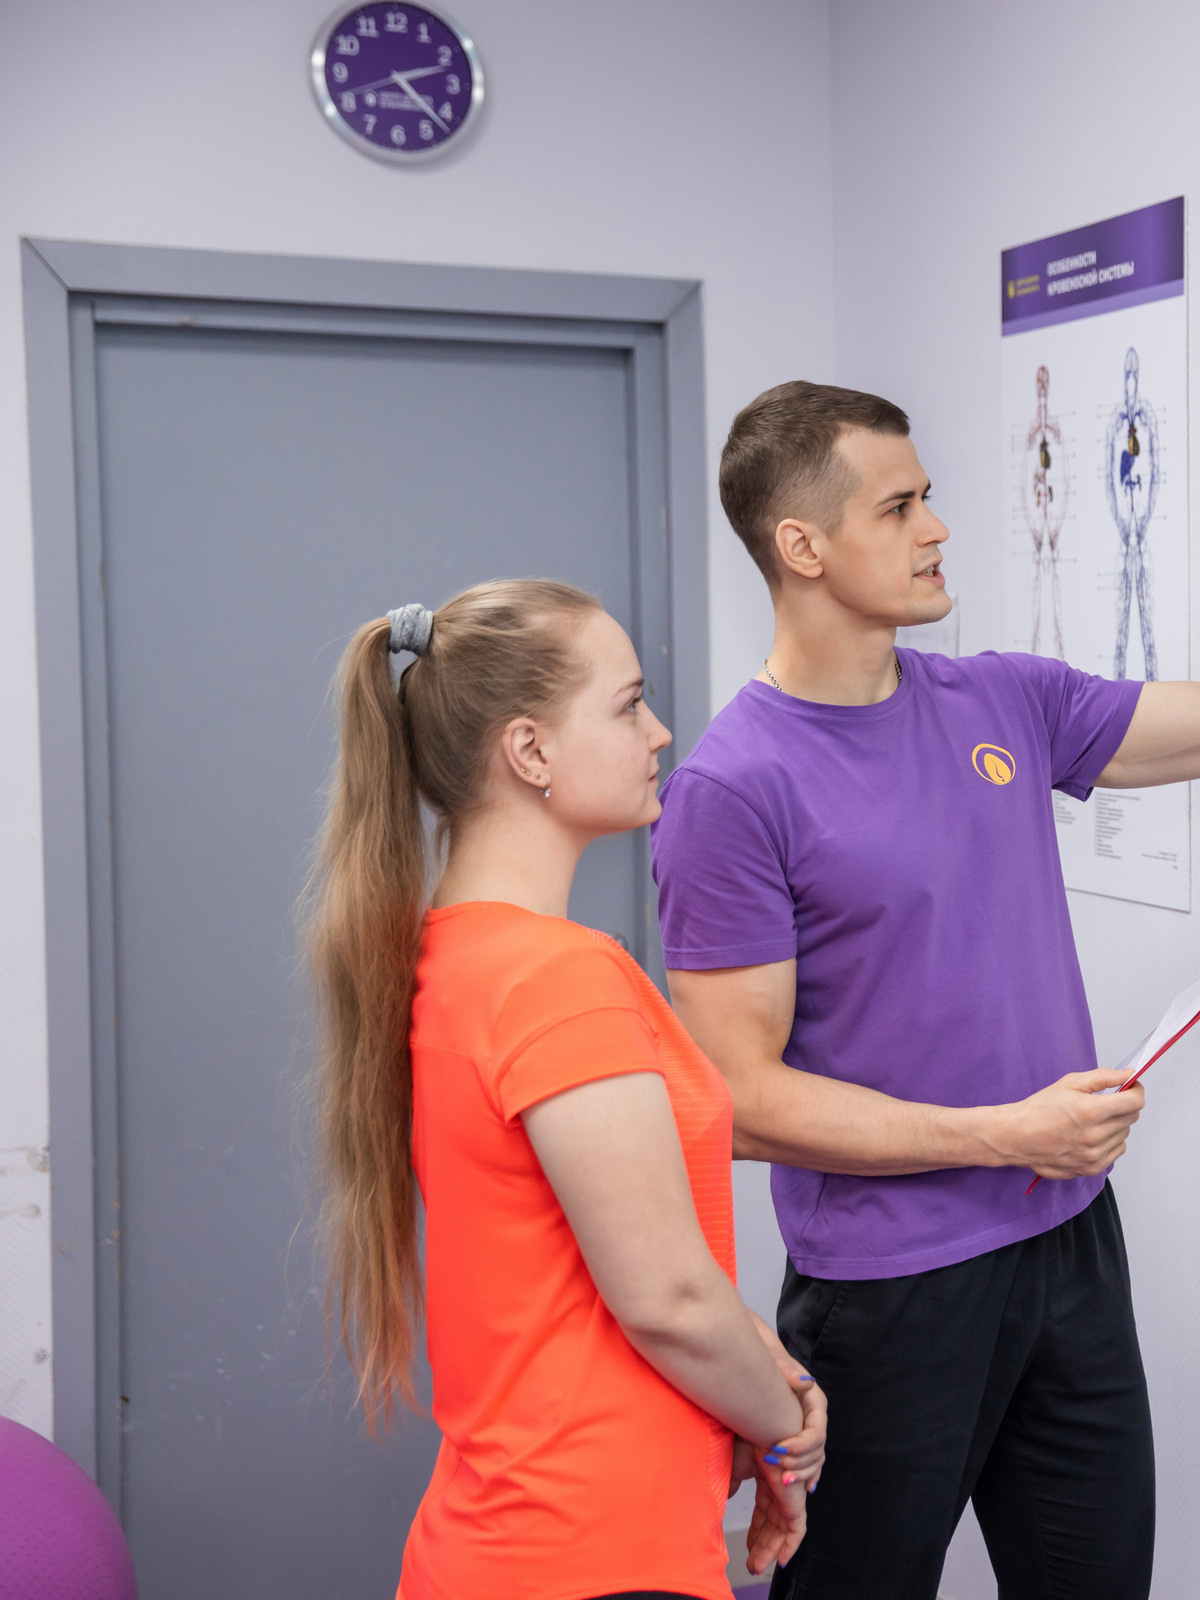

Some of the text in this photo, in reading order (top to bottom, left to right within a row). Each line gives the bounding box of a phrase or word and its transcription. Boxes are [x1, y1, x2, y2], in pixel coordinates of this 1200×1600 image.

[357, 16, 379, 37] 11
[385, 11, 408, 33] 12
[417, 22, 431, 43] 1
[335, 34, 360, 56] 10
[437, 45, 453, 67] 2
[332, 62, 348, 83] 9
[445, 73, 461, 95] 3
[340, 91, 357, 113] 8
[439, 101, 453, 122] 4
[362, 113, 378, 135] 7
[390, 124, 407, 146] 6
[418, 119, 434, 141] 5
[1047, 250, 1097, 276] ОСОБЕННОСТИ
[1047, 270, 1097, 297] КРОВЕНОСНОЙ
[1099, 261, 1135, 284] СИСТЕМЫ
